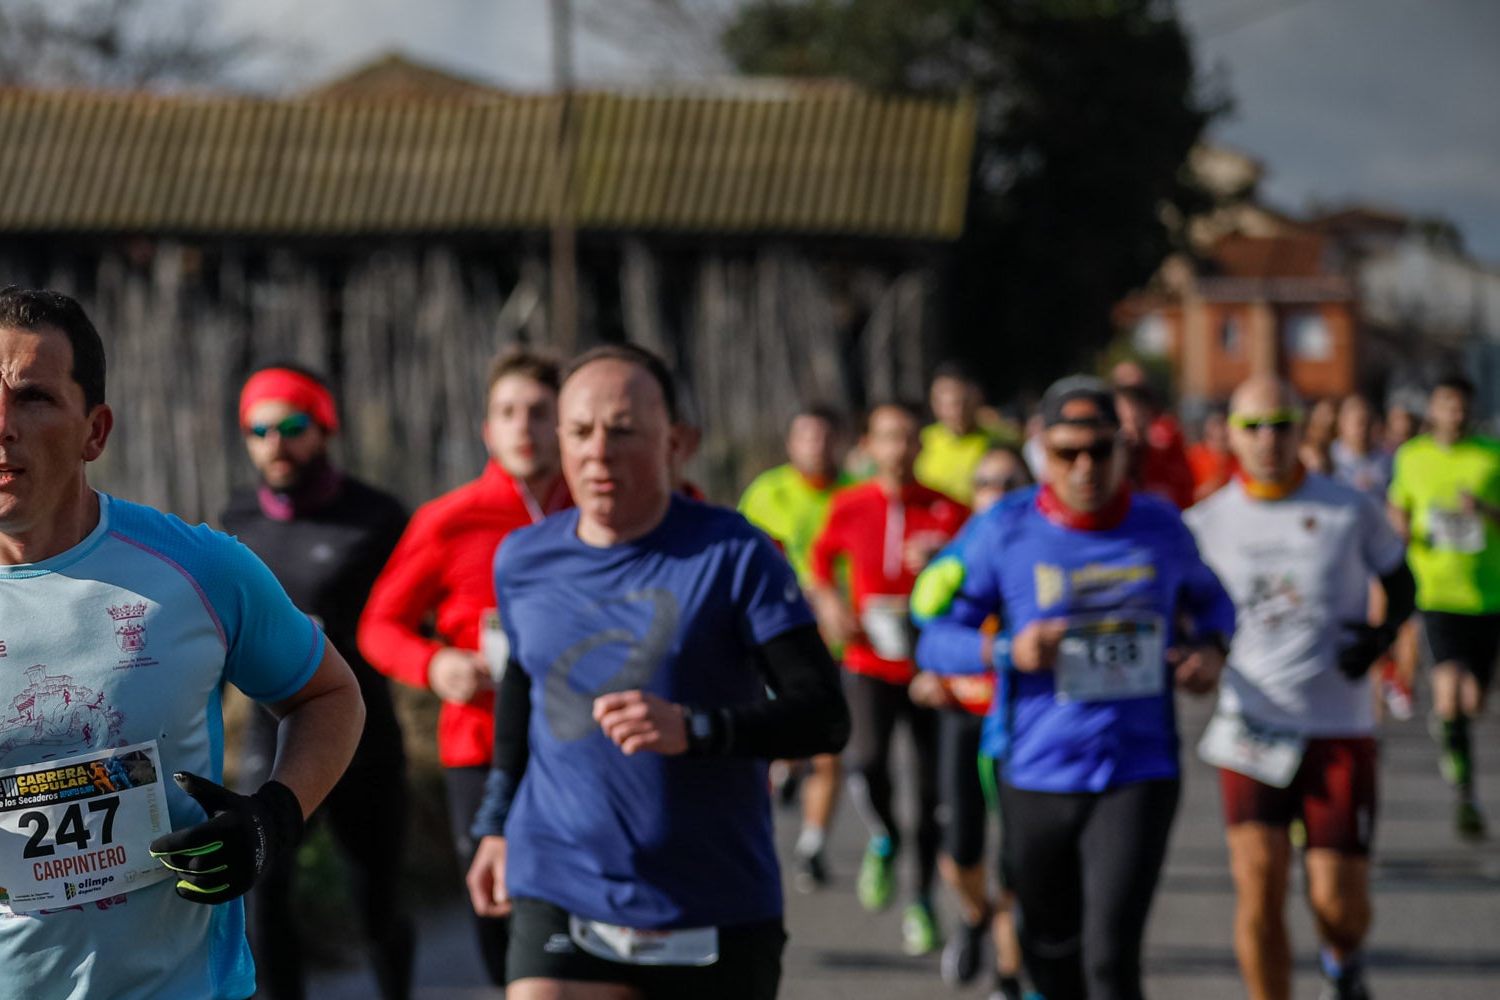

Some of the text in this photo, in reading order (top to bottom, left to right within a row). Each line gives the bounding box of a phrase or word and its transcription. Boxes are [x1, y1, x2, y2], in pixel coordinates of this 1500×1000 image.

[17, 765, 87, 787] CARRERA
[19, 776, 89, 796] POPULAR
[5, 797, 17, 807] los
[18, 793, 58, 806] Secaderos
[18, 795, 121, 860] 247
[33, 845, 128, 882] CARPINTERO
[78, 875, 115, 889] olimpo
